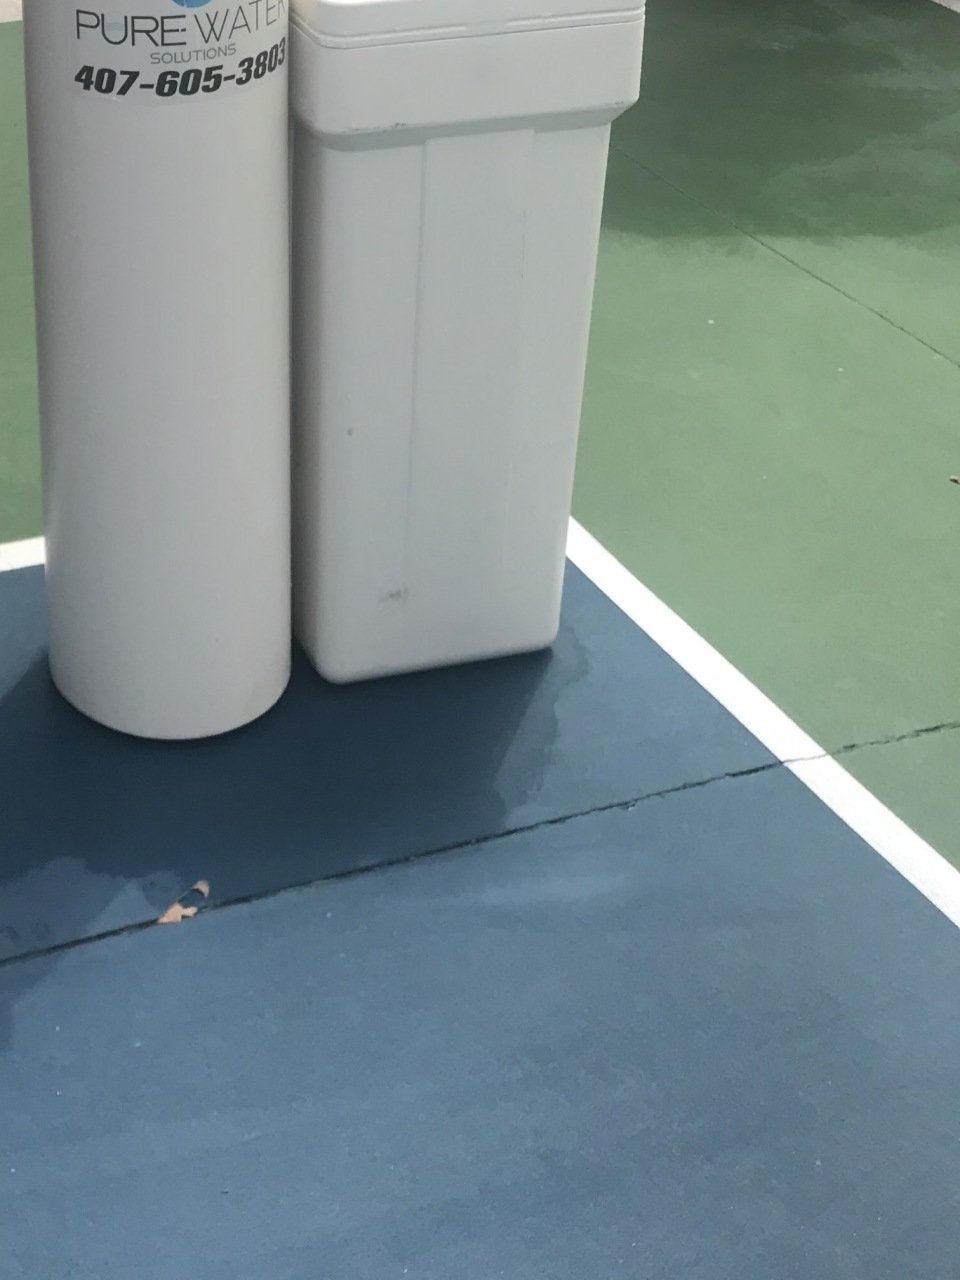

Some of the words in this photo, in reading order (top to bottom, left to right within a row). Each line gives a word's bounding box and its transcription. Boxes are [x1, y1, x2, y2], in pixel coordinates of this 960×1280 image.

[76, 9, 186, 47] PURE
[74, 36, 286, 97] 407-605-3803
[150, 43, 237, 65] SOLUTIONS
